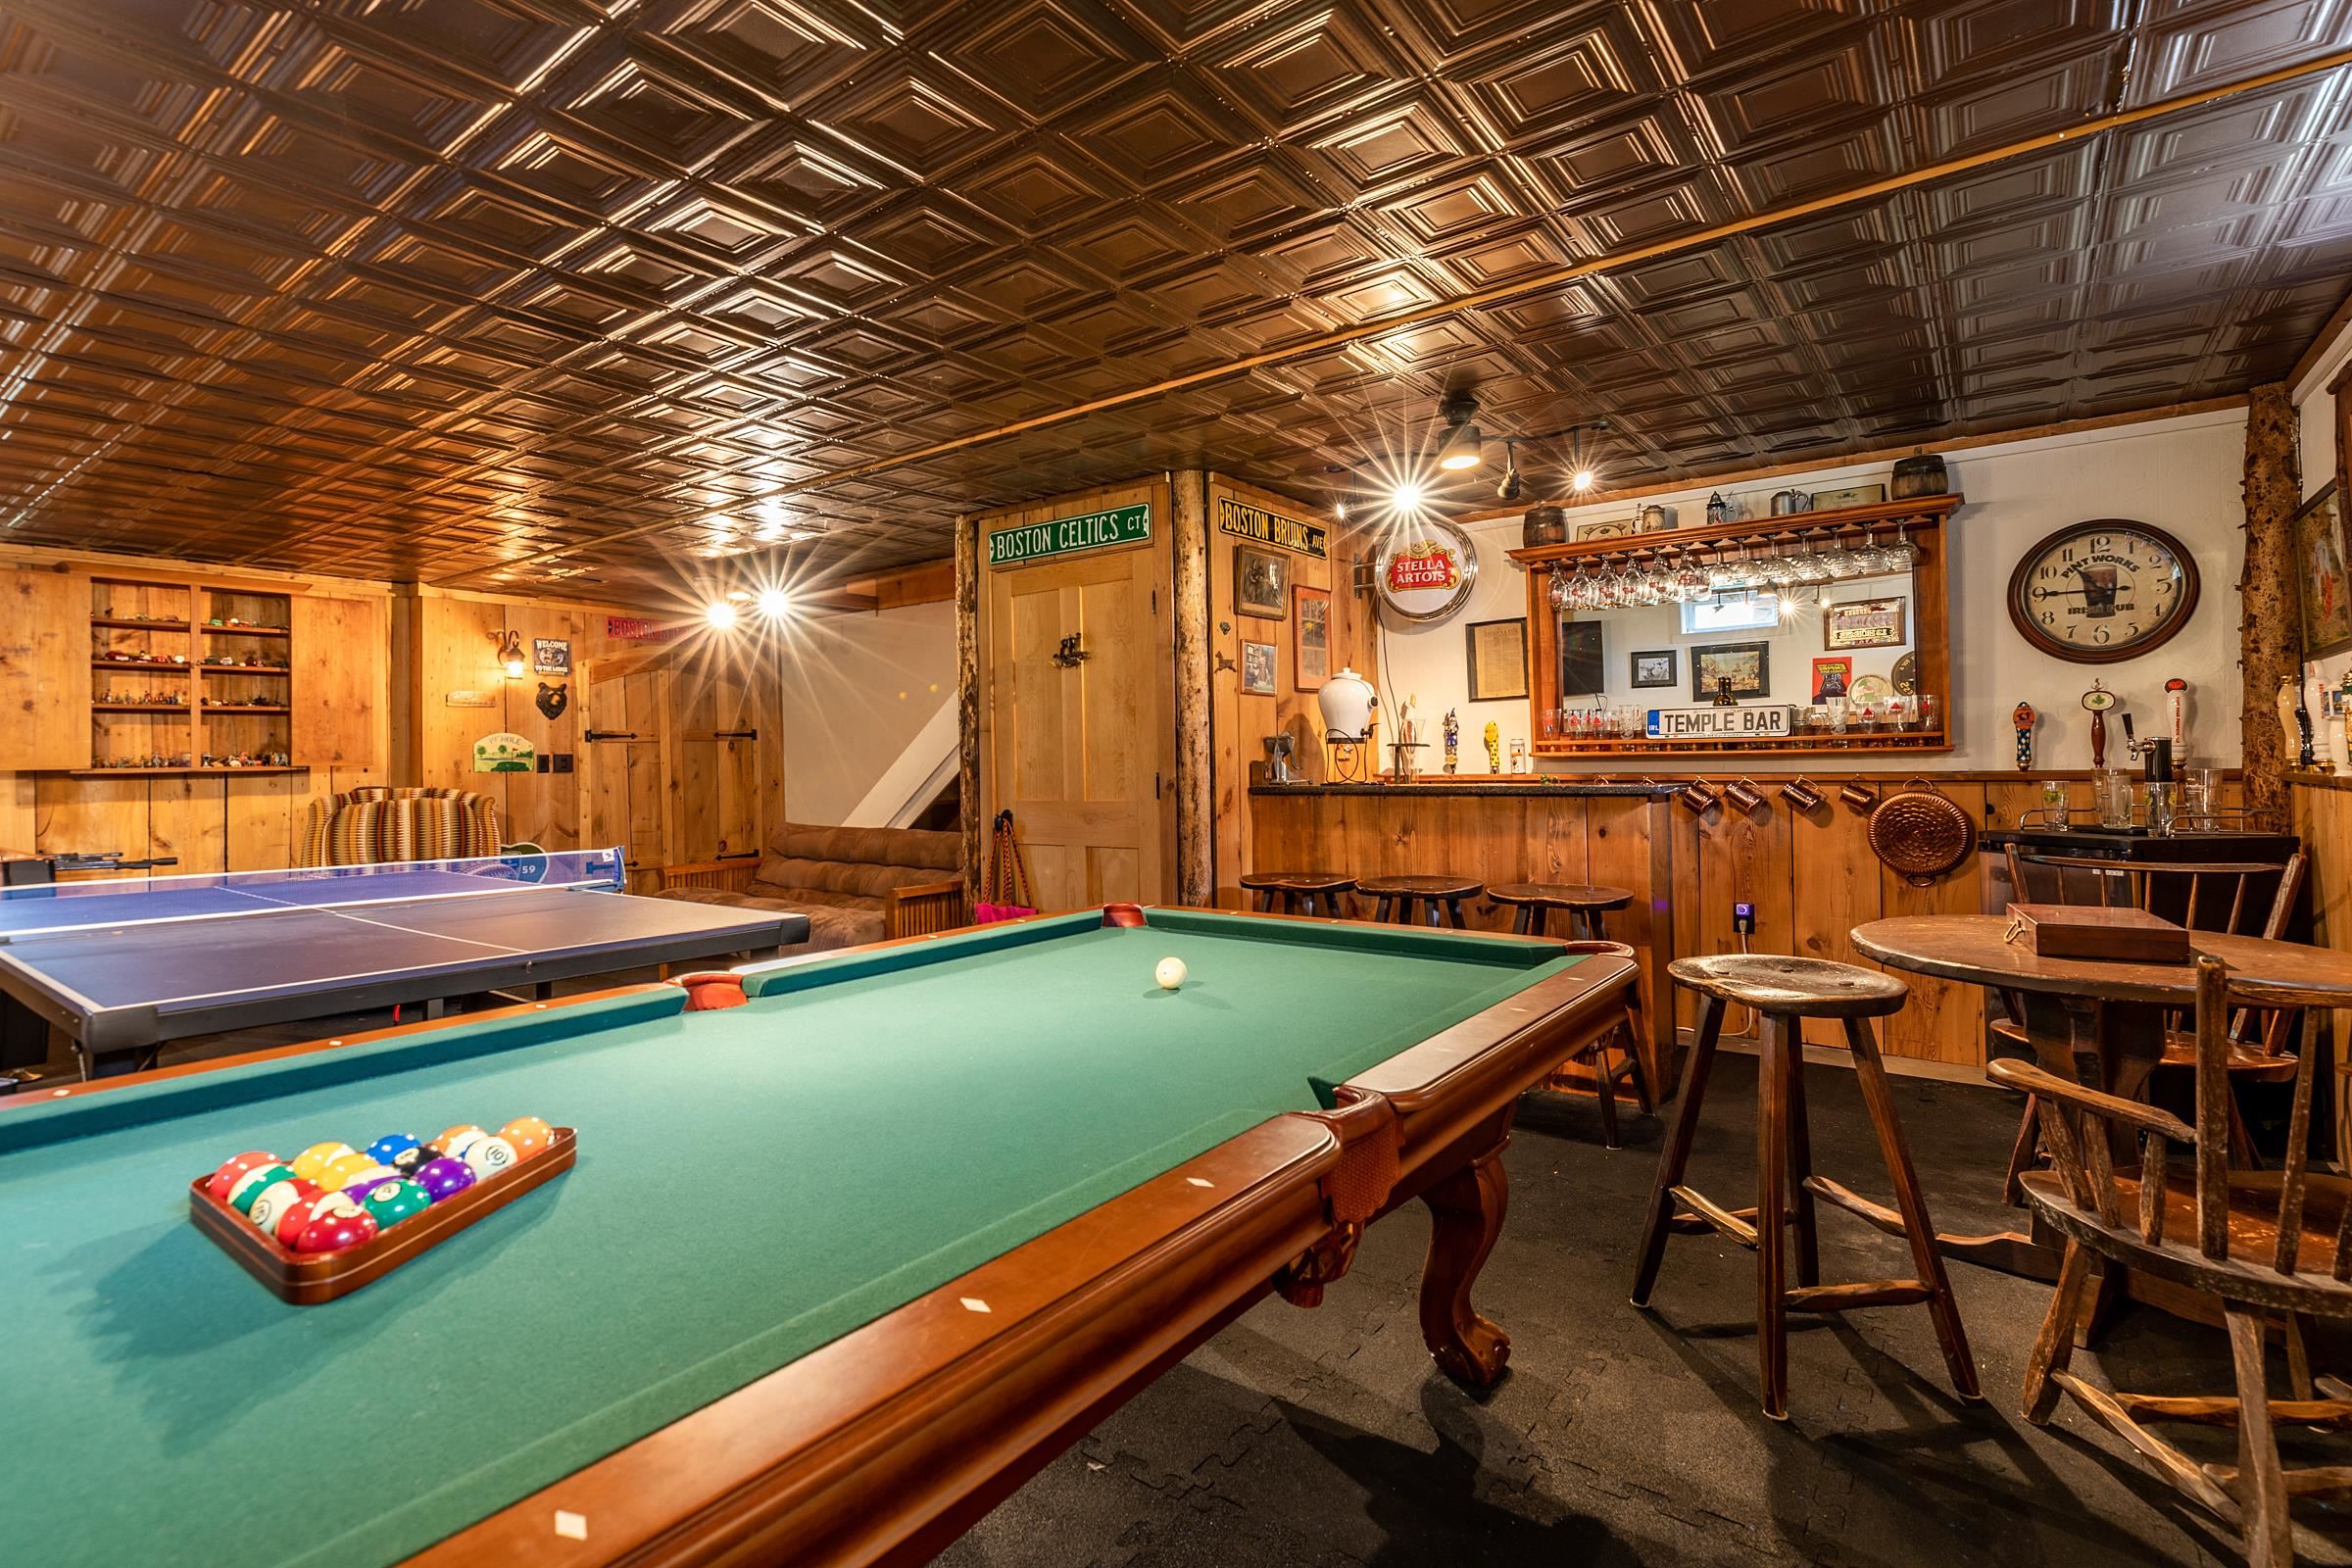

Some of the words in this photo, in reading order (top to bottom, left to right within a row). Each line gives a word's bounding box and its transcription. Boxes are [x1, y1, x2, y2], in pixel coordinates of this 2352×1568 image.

[1225, 503, 1269, 540] BOSTON
[1275, 516, 1308, 551] BRUINS
[1312, 534, 1324, 550] AVE
[997, 526, 1052, 559] BOSTON
[1059, 514, 1119, 549] CELTICS
[1128, 515, 1141, 530] CT
[2089, 536, 2111, 555] 12
[2129, 540, 2134, 555] 1
[2062, 548, 2074, 563] 11
[2149, 555, 2162, 569] 2
[1397, 560, 1446, 572] STELLA
[2040, 564, 2057, 579] 10
[2061, 558, 2089, 578] PINT
[2091, 555, 2140, 572] WORKS
[1397, 570, 1446, 583] ARTOIS
[2032, 586, 2047, 603] 9
[2068, 605, 2103, 615] IRISH
[2107, 603, 2134, 613] PUB
[2148, 603, 2164, 617] 4
[2041, 612, 2055, 625] 8
[2066, 625, 2078, 639] 7
[2093, 625, 2110, 644] 6
[2125, 622, 2138, 637] 5
[536, 640, 567, 652] WELCOME
[1665, 712, 1735, 733] TEMPLE
[1743, 711, 1781, 731] BAR
[521, 865, 536, 874] 59
[490, 1148, 504, 1160] 10
